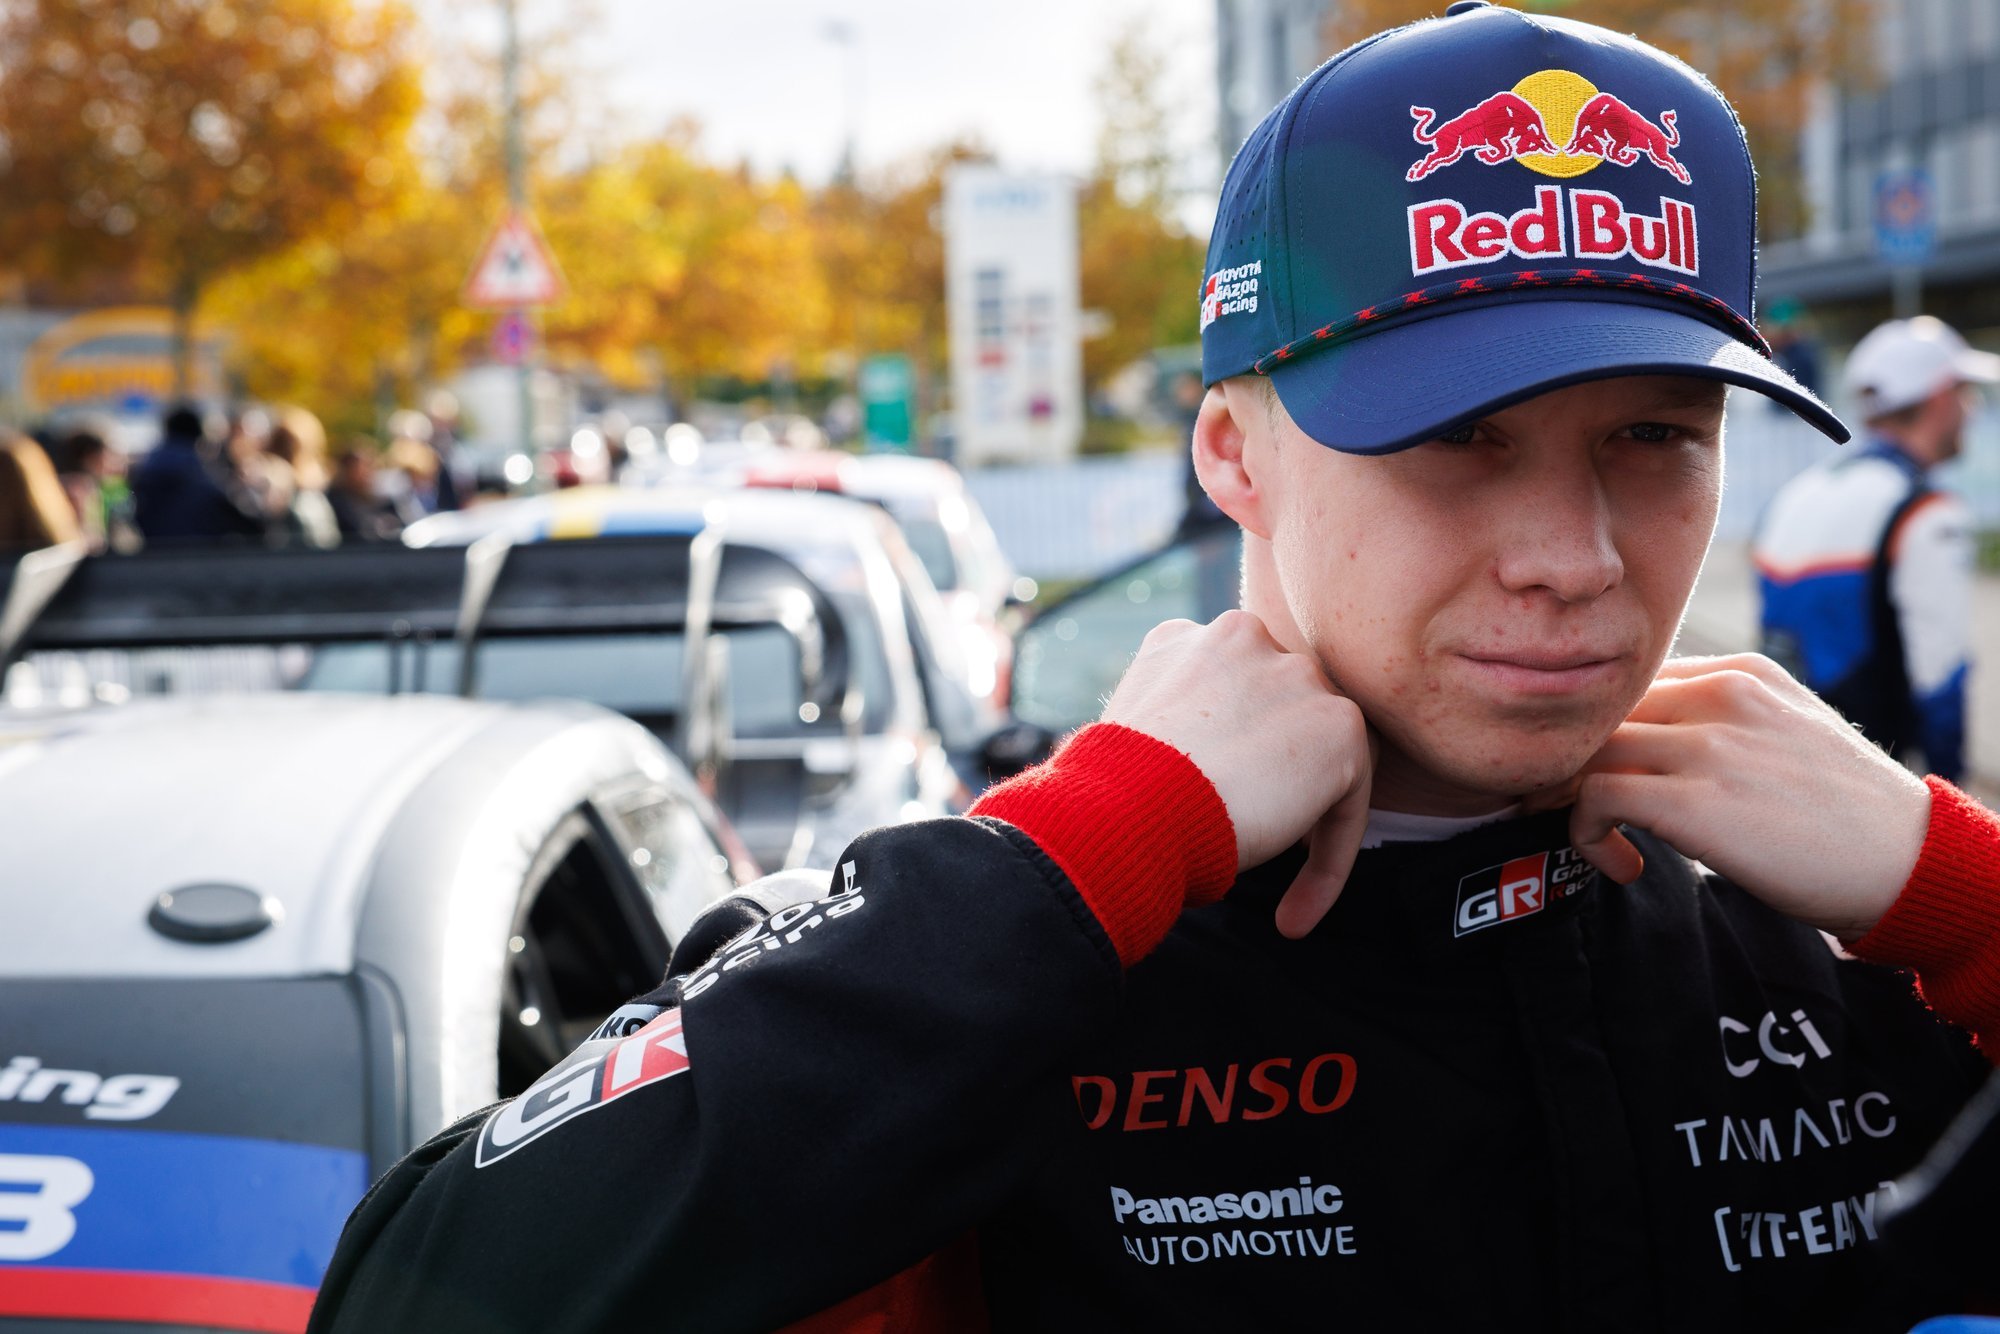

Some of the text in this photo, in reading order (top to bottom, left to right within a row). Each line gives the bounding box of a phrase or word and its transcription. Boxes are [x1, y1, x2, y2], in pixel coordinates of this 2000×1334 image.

[1407, 185, 1699, 278] Red Bull
[1216, 278, 1259, 301] GAZOO
[1217, 260, 1262, 285] TOYOTA
[1458, 877, 1540, 929] GR
[1072, 1053, 1358, 1131] DENSO
[1110, 1176, 1343, 1225] Panasonic
[1123, 1226, 1357, 1265] AUTOMOTIVE
